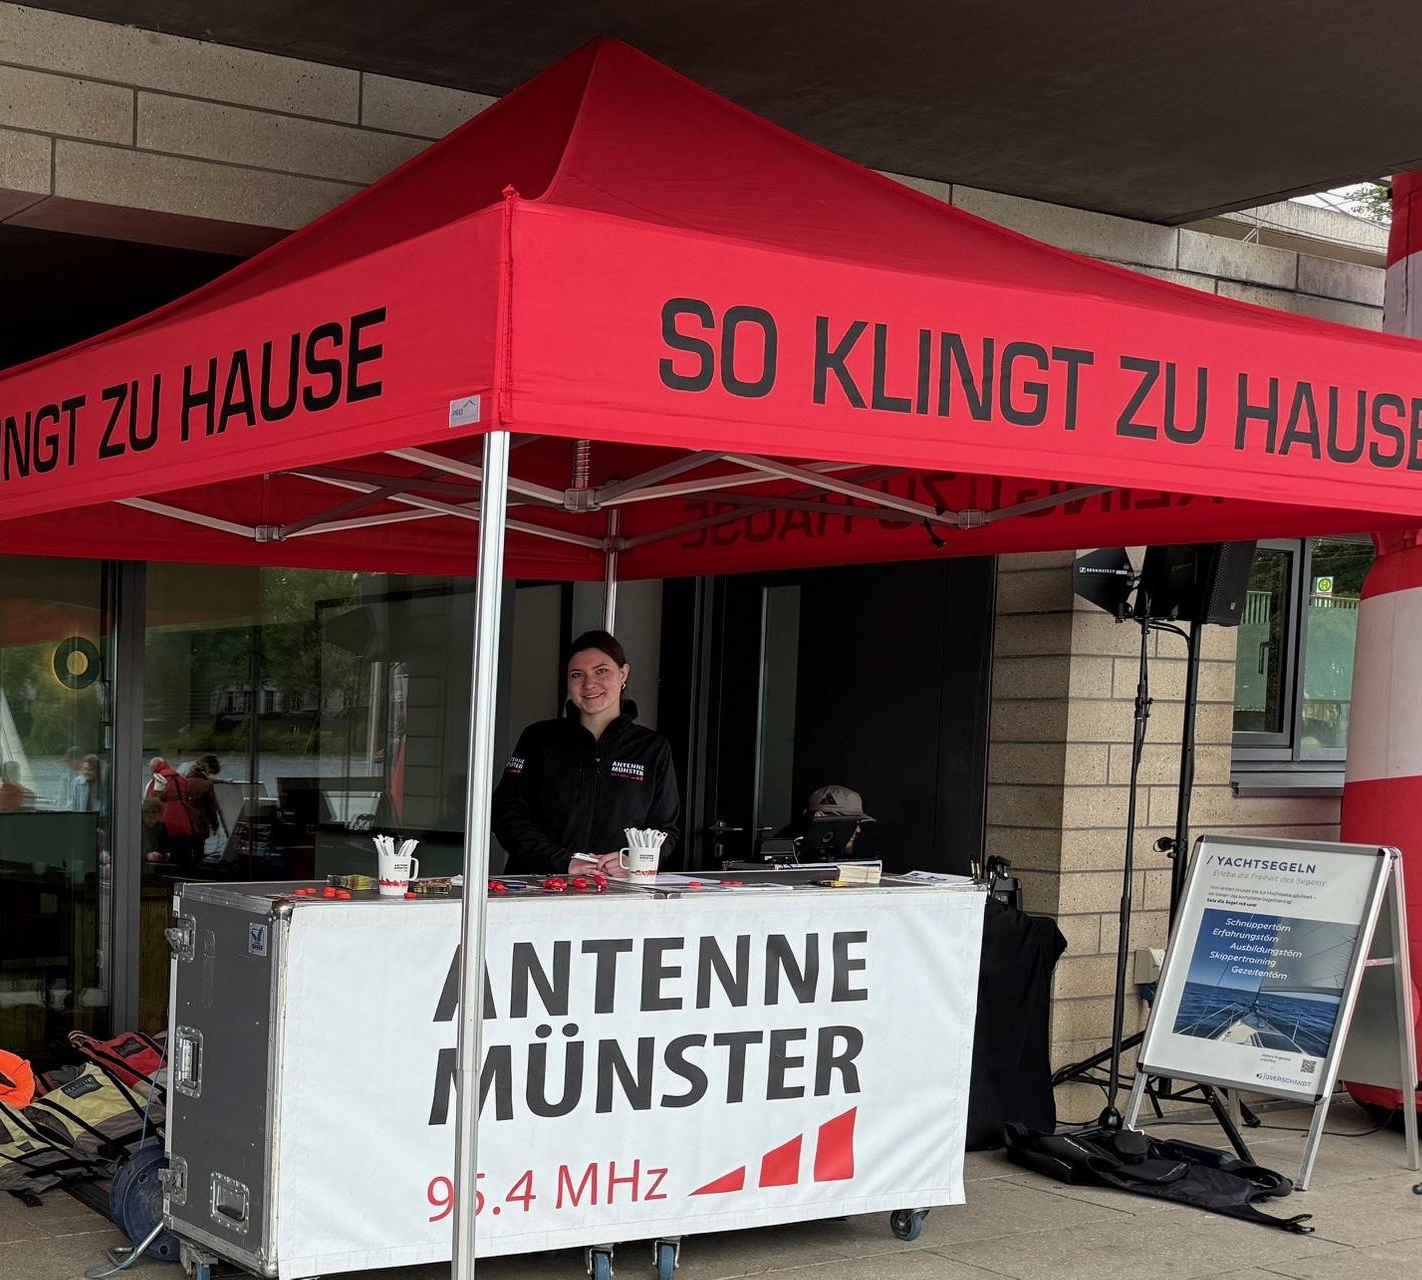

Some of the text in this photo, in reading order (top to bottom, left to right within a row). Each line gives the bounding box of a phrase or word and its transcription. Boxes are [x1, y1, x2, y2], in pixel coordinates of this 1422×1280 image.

[98, 374, 162, 460] ZU
[180, 307, 386, 442] HAUSE
[658, 297, 1422, 470] SO KLINGT ZU HAUSE
[1217, 856, 1316, 874] YACHTSEGELN
[1226, 918, 1291, 933] Schnuppertörn
[1212, 928, 1279, 943] Erfahrungstörn
[1229, 942, 1303, 958] Ausbildungstörn
[1209, 951, 1277, 968] Skippertraining
[432, 931, 868, 1022] ANTENNE
[1231, 965, 1288, 980] Gezeitentörn
[428, 1023, 864, 1126] MÜNSTER
[555, 1159, 669, 1210] MHz
